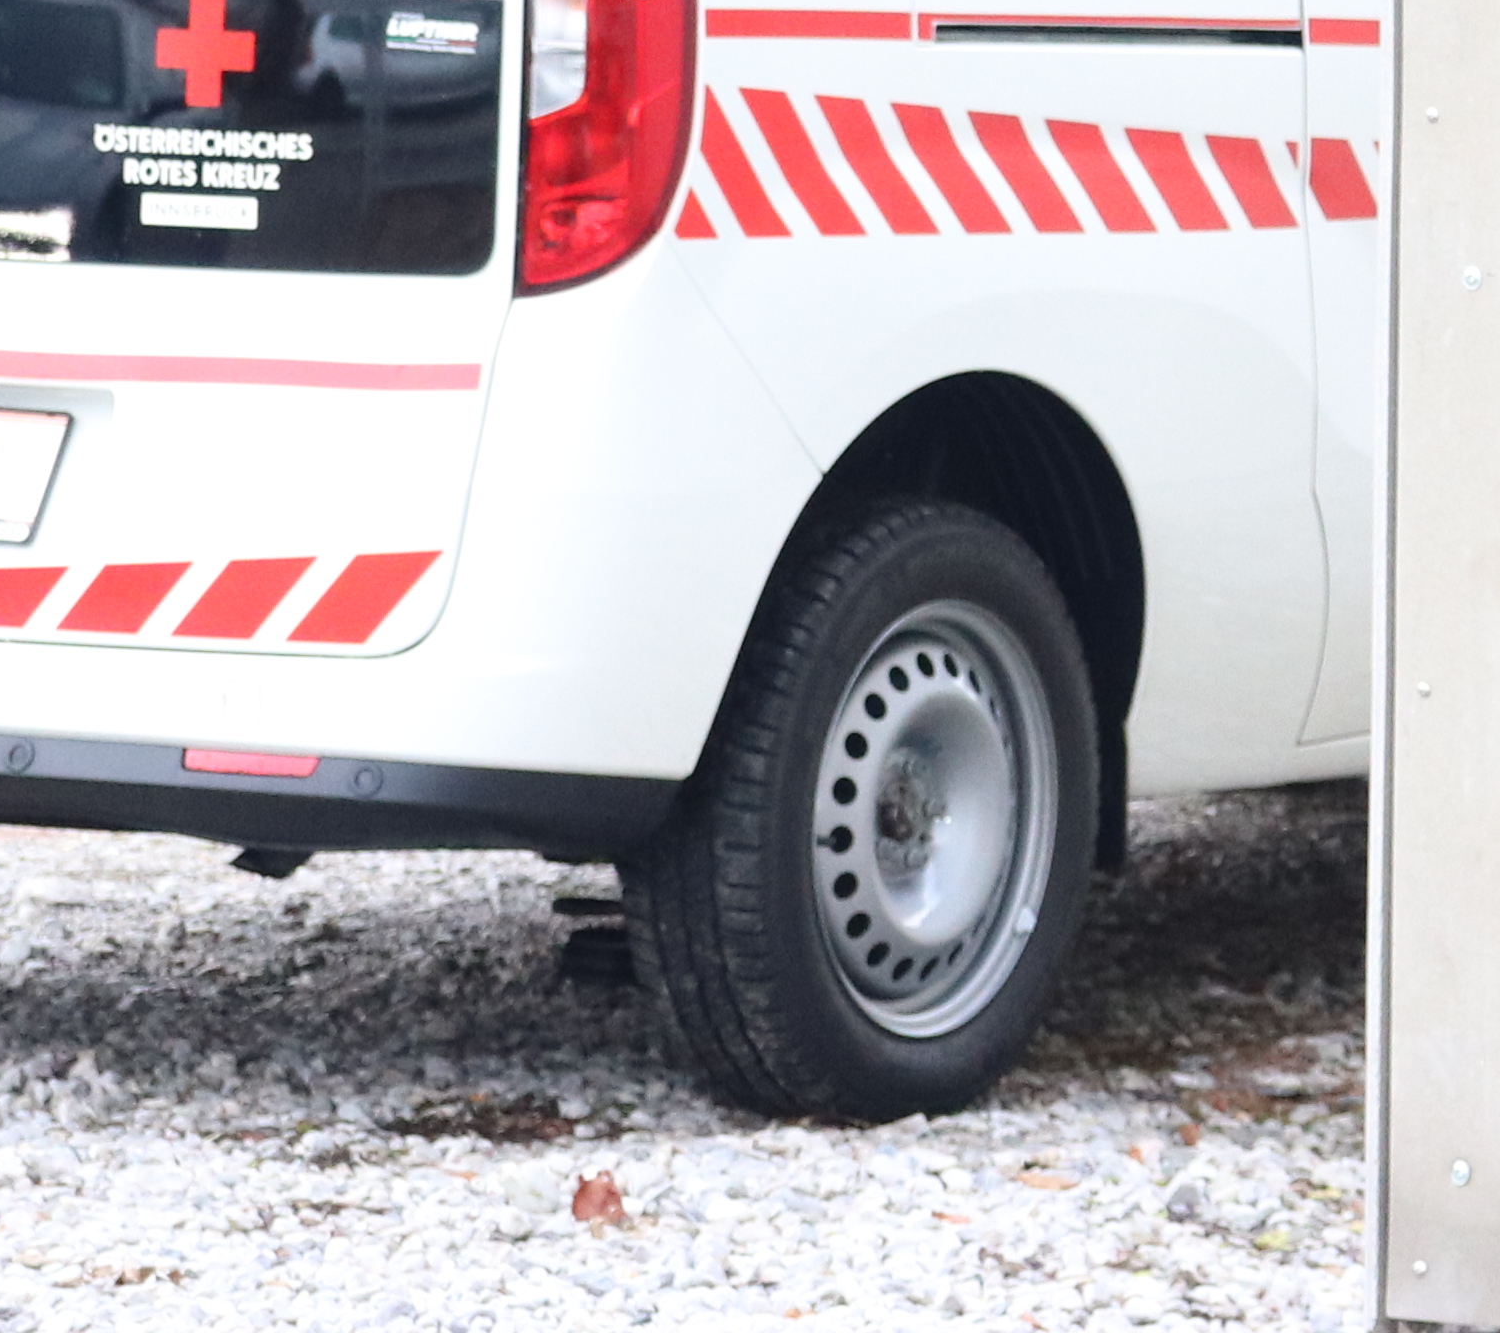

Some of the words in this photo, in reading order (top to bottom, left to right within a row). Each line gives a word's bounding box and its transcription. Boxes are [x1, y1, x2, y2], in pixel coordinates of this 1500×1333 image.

[92, 121, 314, 162] ÖSTERREICHISCHES
[122, 157, 198, 187] ROTES
[201, 161, 282, 191] KREUZ
